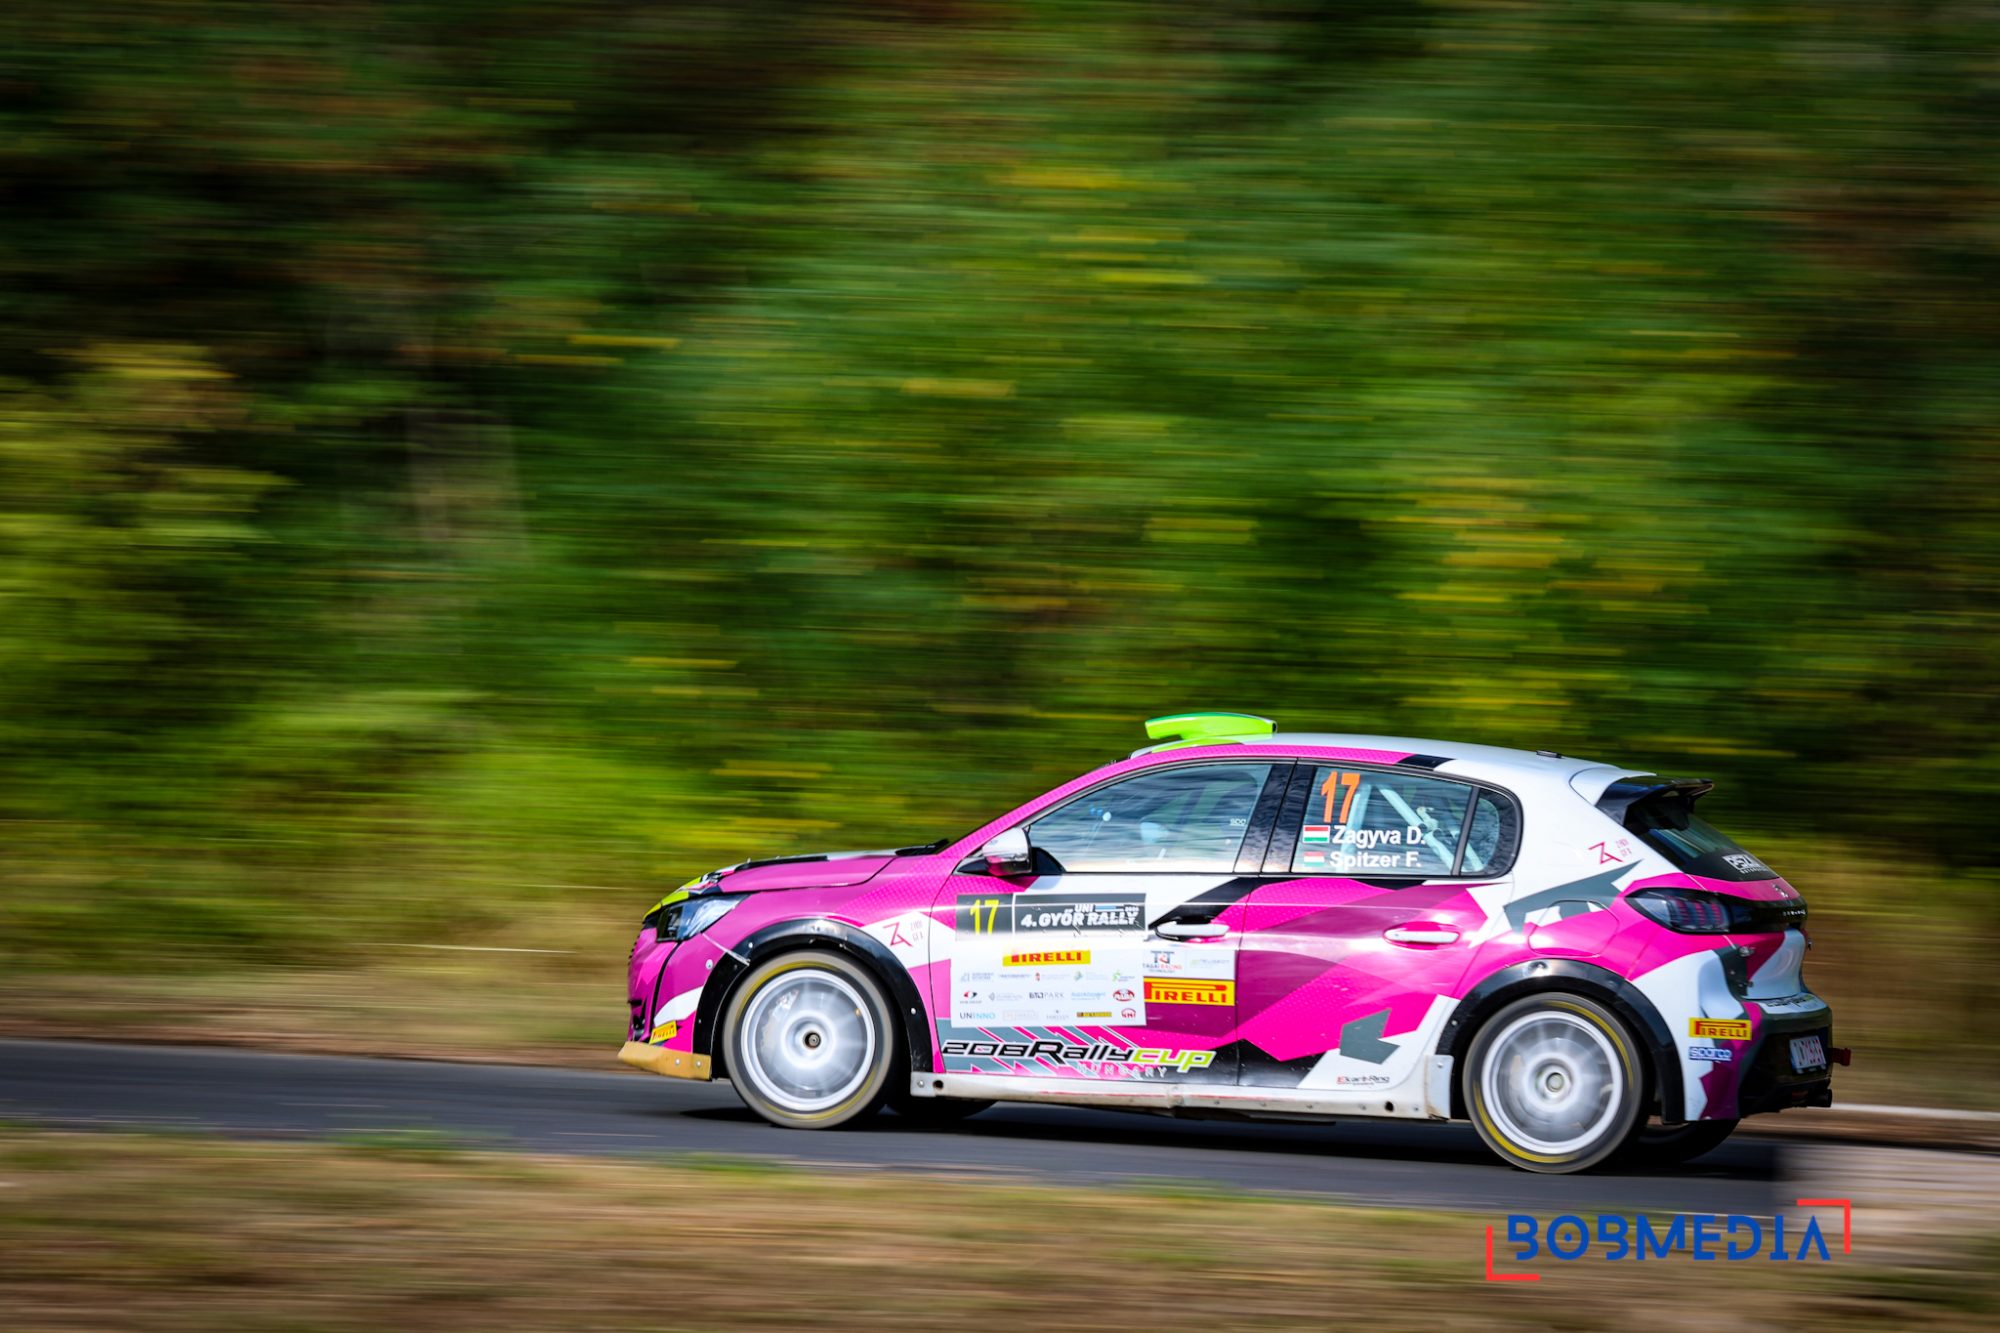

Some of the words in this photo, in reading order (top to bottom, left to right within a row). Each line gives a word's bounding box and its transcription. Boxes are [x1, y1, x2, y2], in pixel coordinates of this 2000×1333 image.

[1320, 770, 1361, 823] 17
[1331, 825, 1401, 848] Zagyva
[1406, 826, 1426, 844] D.
[1329, 851, 1401, 871] Spitzer
[1405, 851, 1422, 868] F.
[969, 899, 999, 934] 17
[1087, 911, 1138, 926] RALLY
[1143, 981, 1227, 1003] PIRELLI
[1694, 1020, 1747, 1037] PIRELLI
